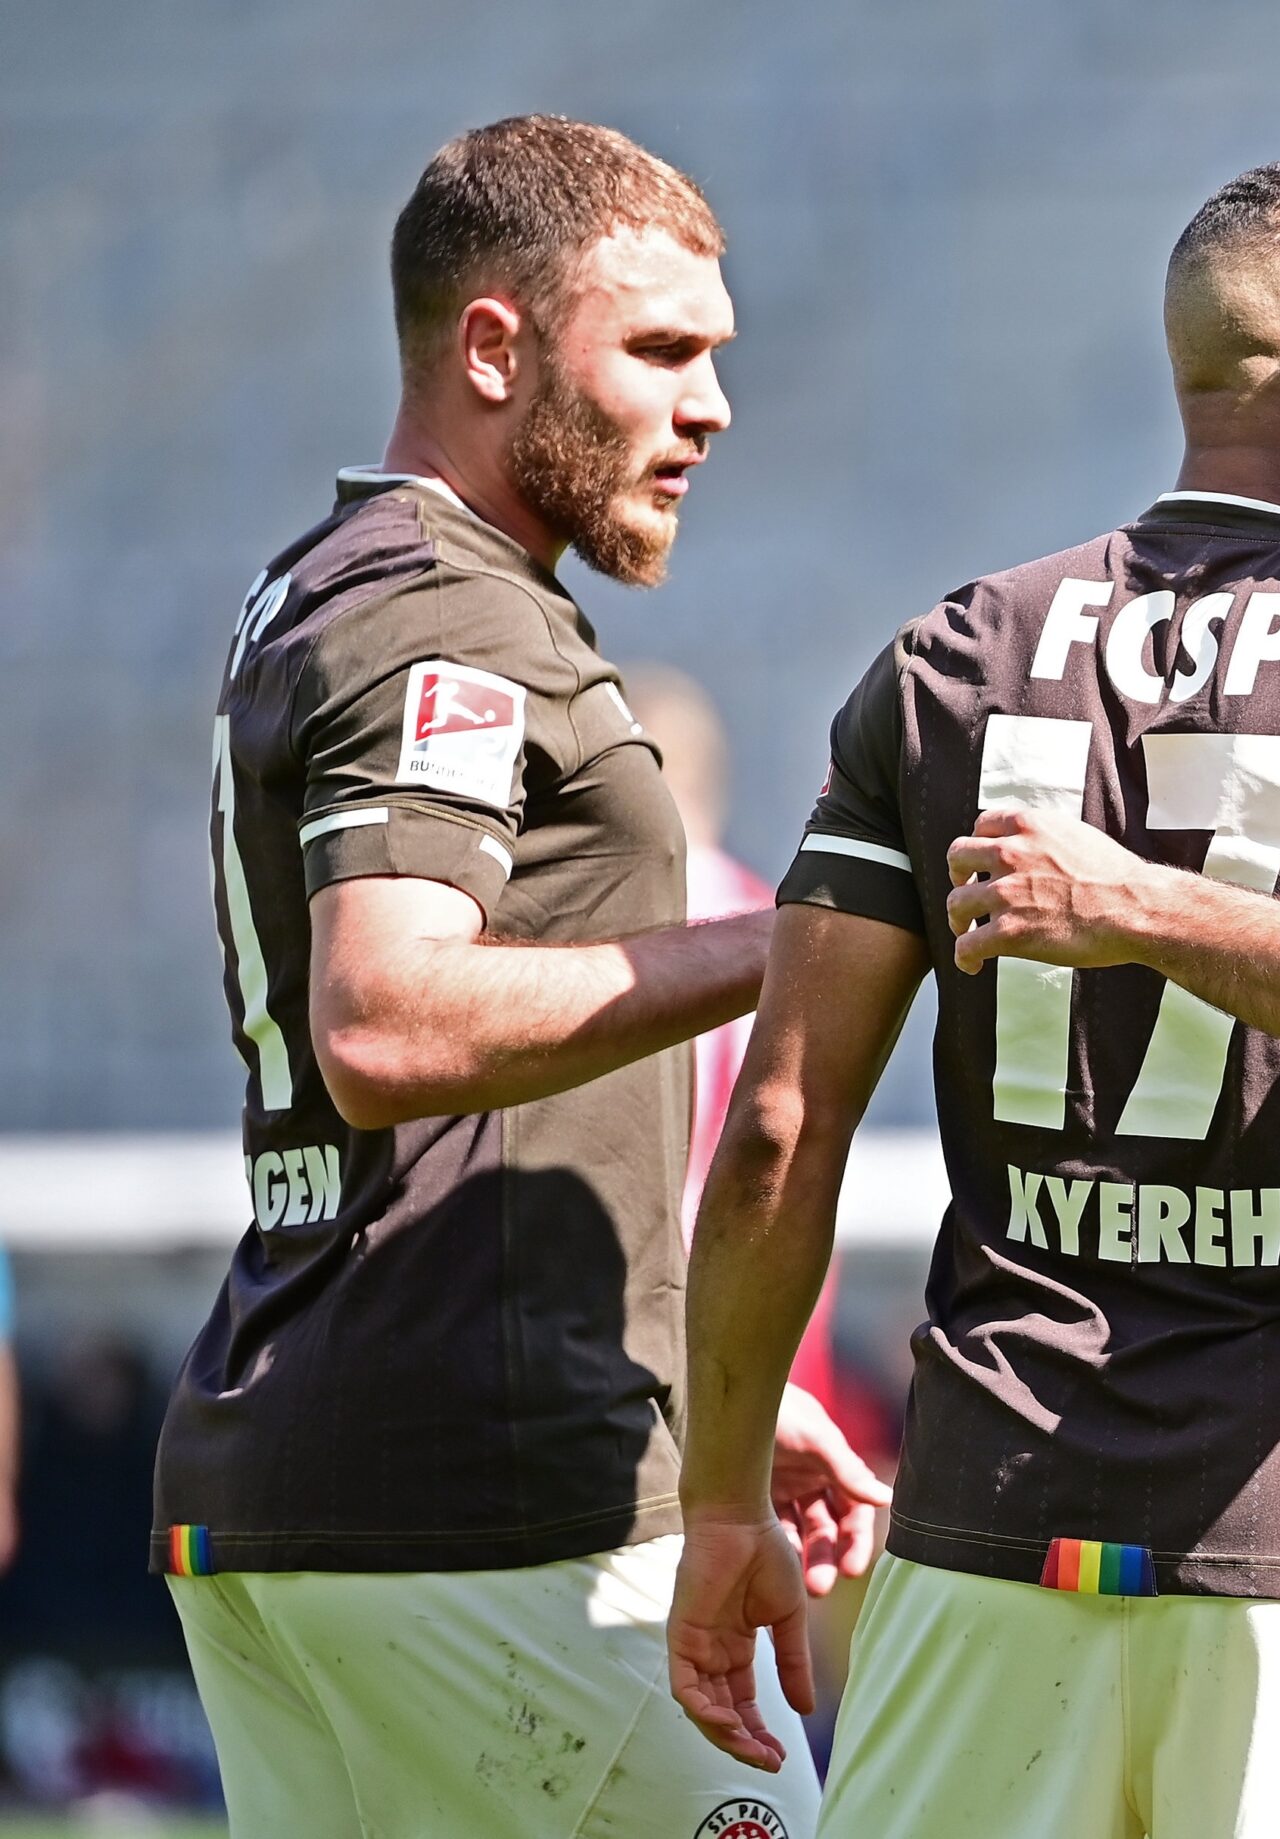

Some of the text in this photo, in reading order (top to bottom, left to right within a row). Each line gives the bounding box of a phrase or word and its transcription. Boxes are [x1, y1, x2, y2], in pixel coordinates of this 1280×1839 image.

[244, 1143, 342, 1232] GEN
[707, 1803, 786, 1839] ST. PAUL
